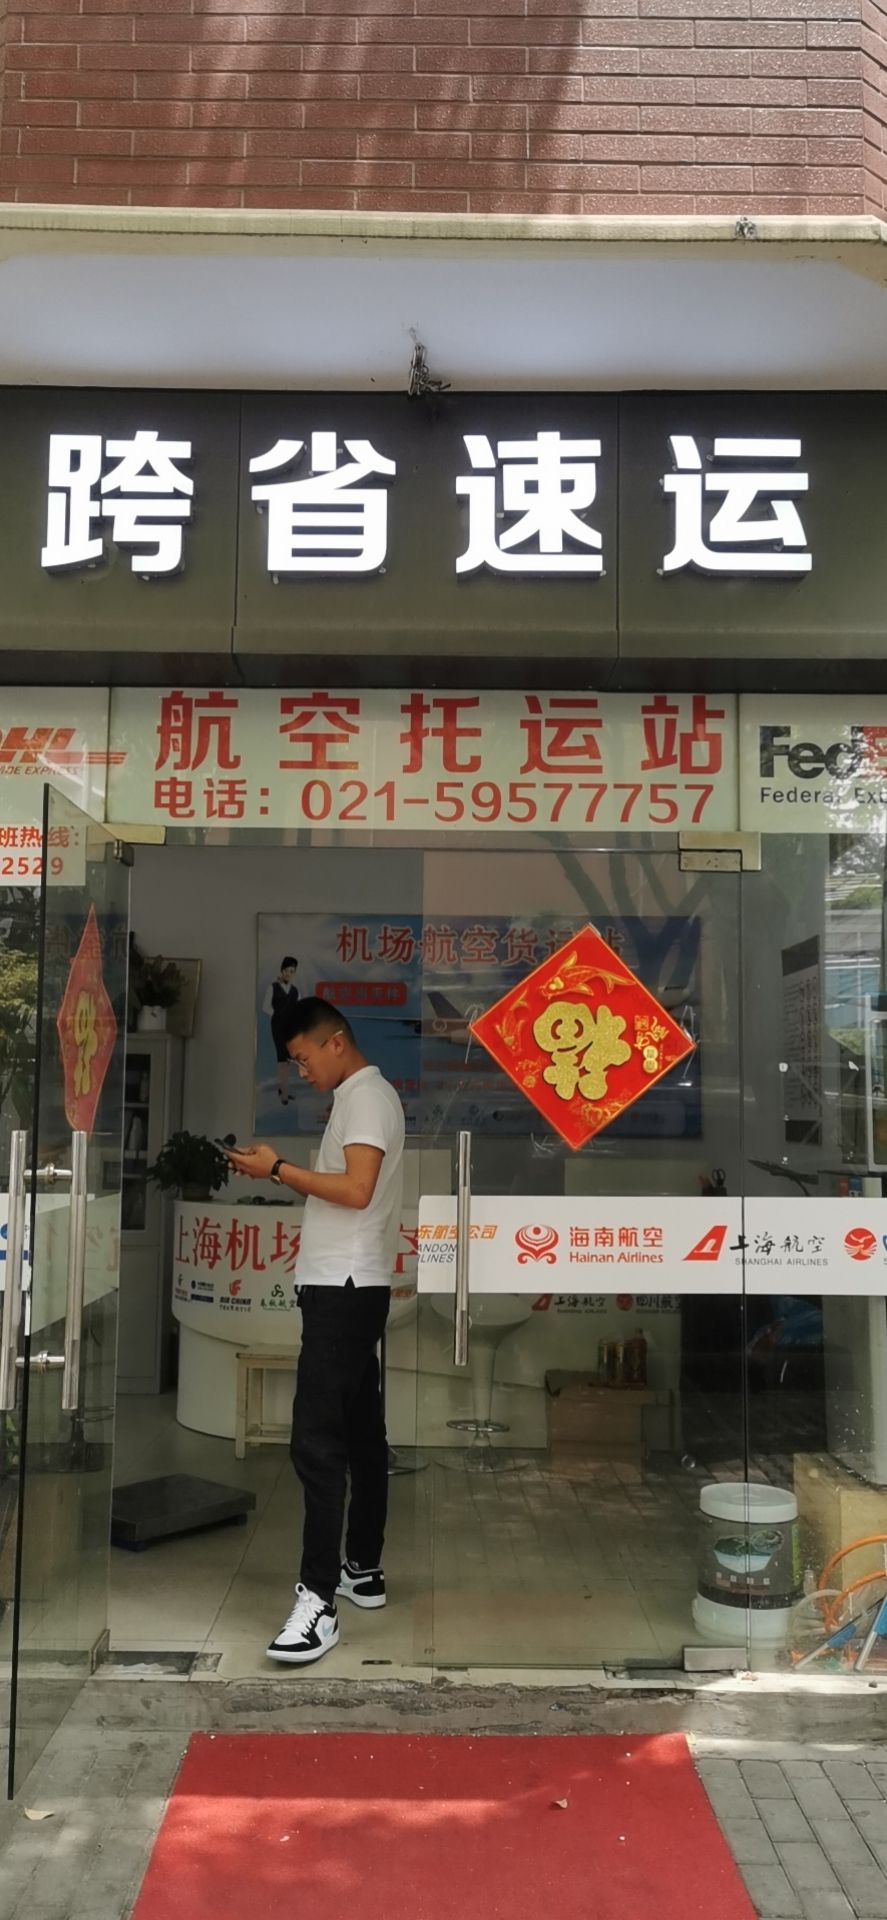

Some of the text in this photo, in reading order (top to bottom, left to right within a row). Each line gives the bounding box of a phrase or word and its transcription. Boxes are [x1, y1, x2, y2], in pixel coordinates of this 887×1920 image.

[42, 431, 812, 573] 跨省速运
[155, 691, 724, 776] 航空托运站
[569, 1226, 663, 1249] 海南航空
[730, 1231, 825, 1256] 上海航空
[569, 1252, 663, 1264] Hainan Airlines
[735, 1257, 828, 1266] SHANGHAI AIRLINES
